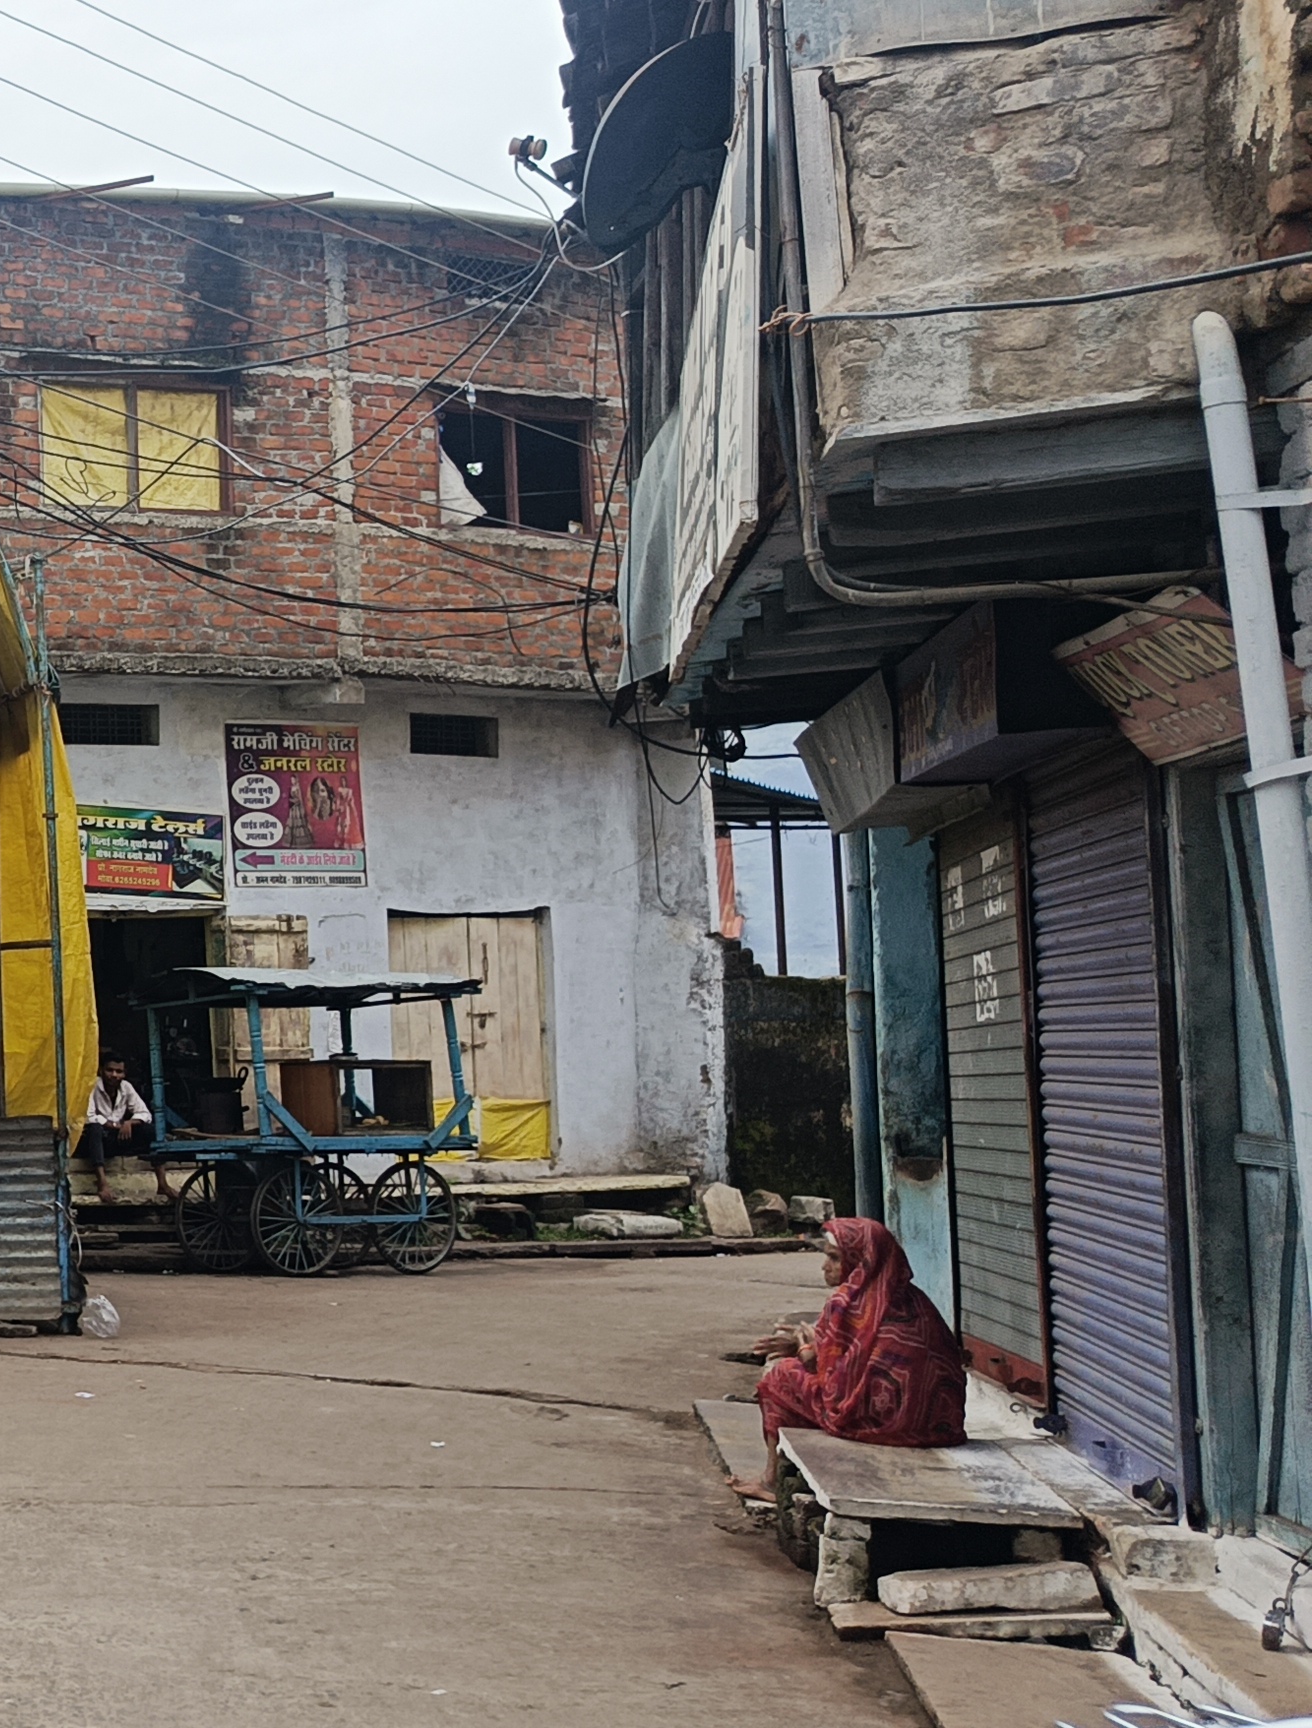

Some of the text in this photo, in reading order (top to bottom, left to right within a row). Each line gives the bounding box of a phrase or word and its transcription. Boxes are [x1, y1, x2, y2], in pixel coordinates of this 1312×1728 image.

[231, 732, 356, 752] रामजी मेचिंग सेंटर
[239, 753, 347, 772] & जनरल स्टोर
[76, 815, 205, 835] ागराज टेलर्स
